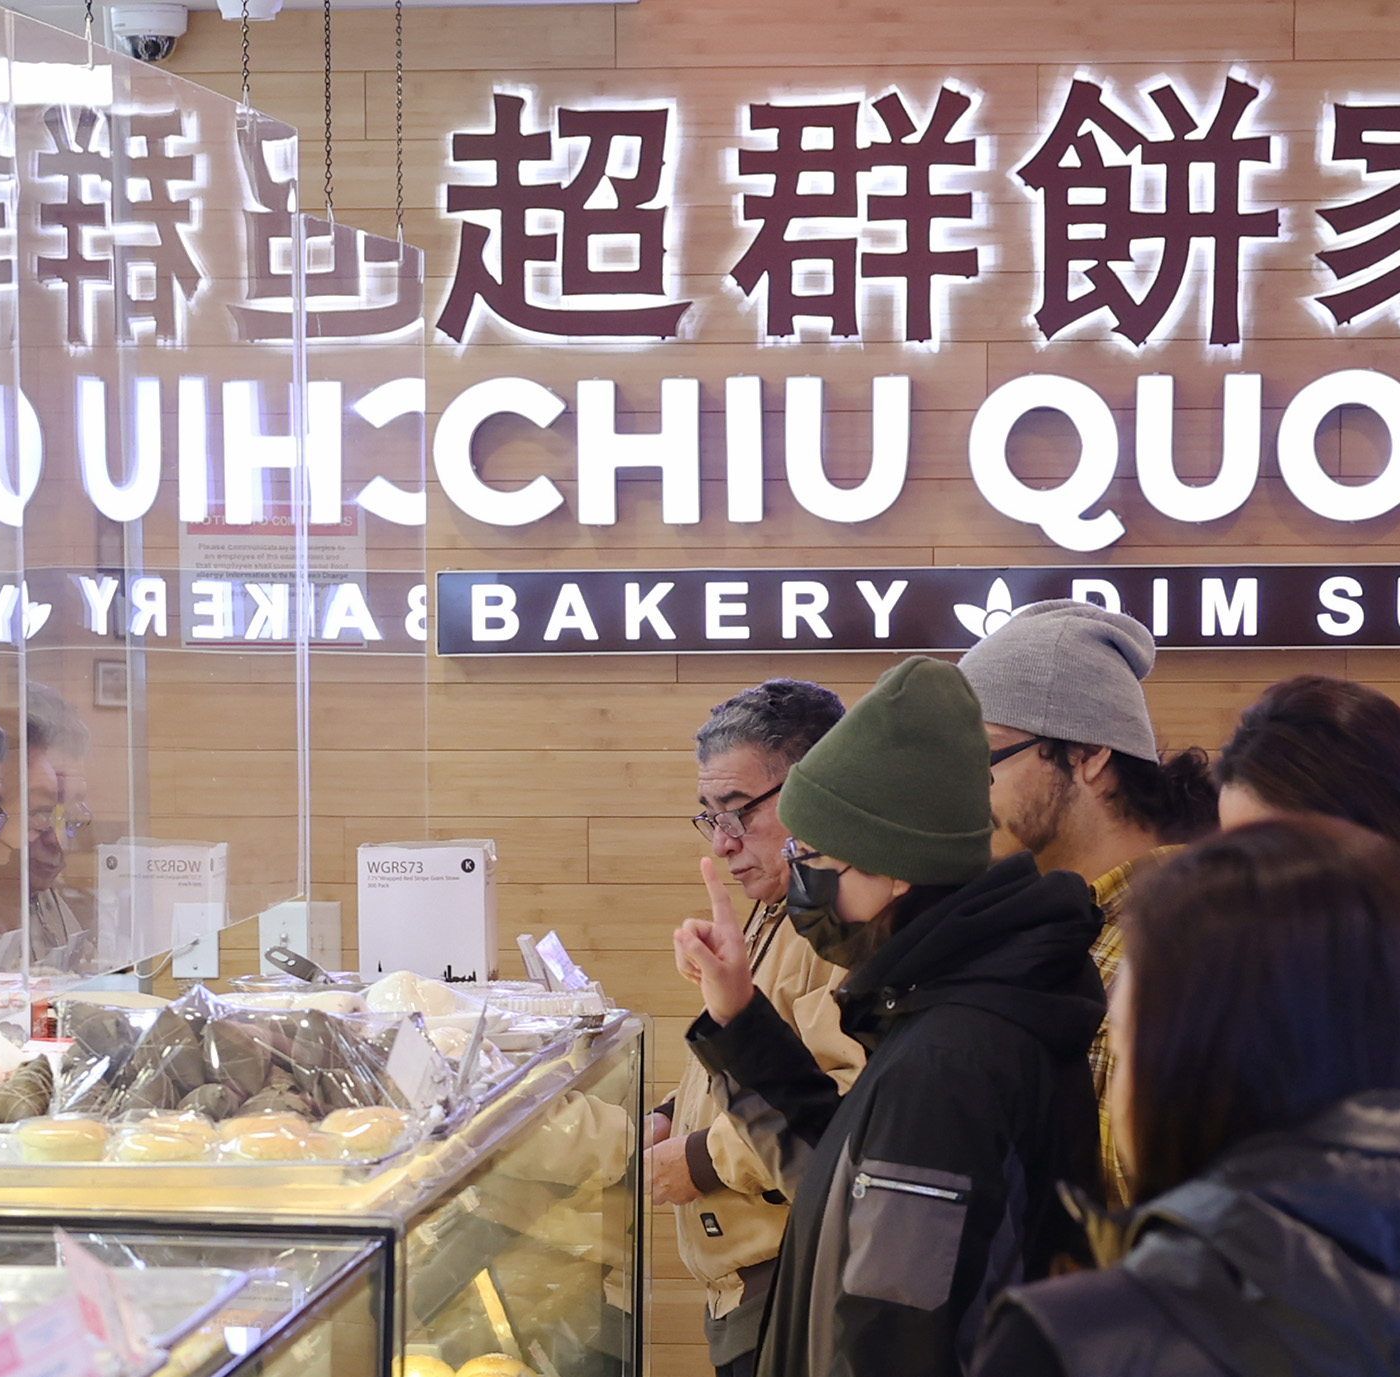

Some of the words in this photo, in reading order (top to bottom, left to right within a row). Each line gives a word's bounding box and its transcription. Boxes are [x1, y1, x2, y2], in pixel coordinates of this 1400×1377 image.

[433, 373, 912, 529] CHIU
[470, 579, 909, 643] BAKERY
[367, 860, 424, 874] WGRS73
